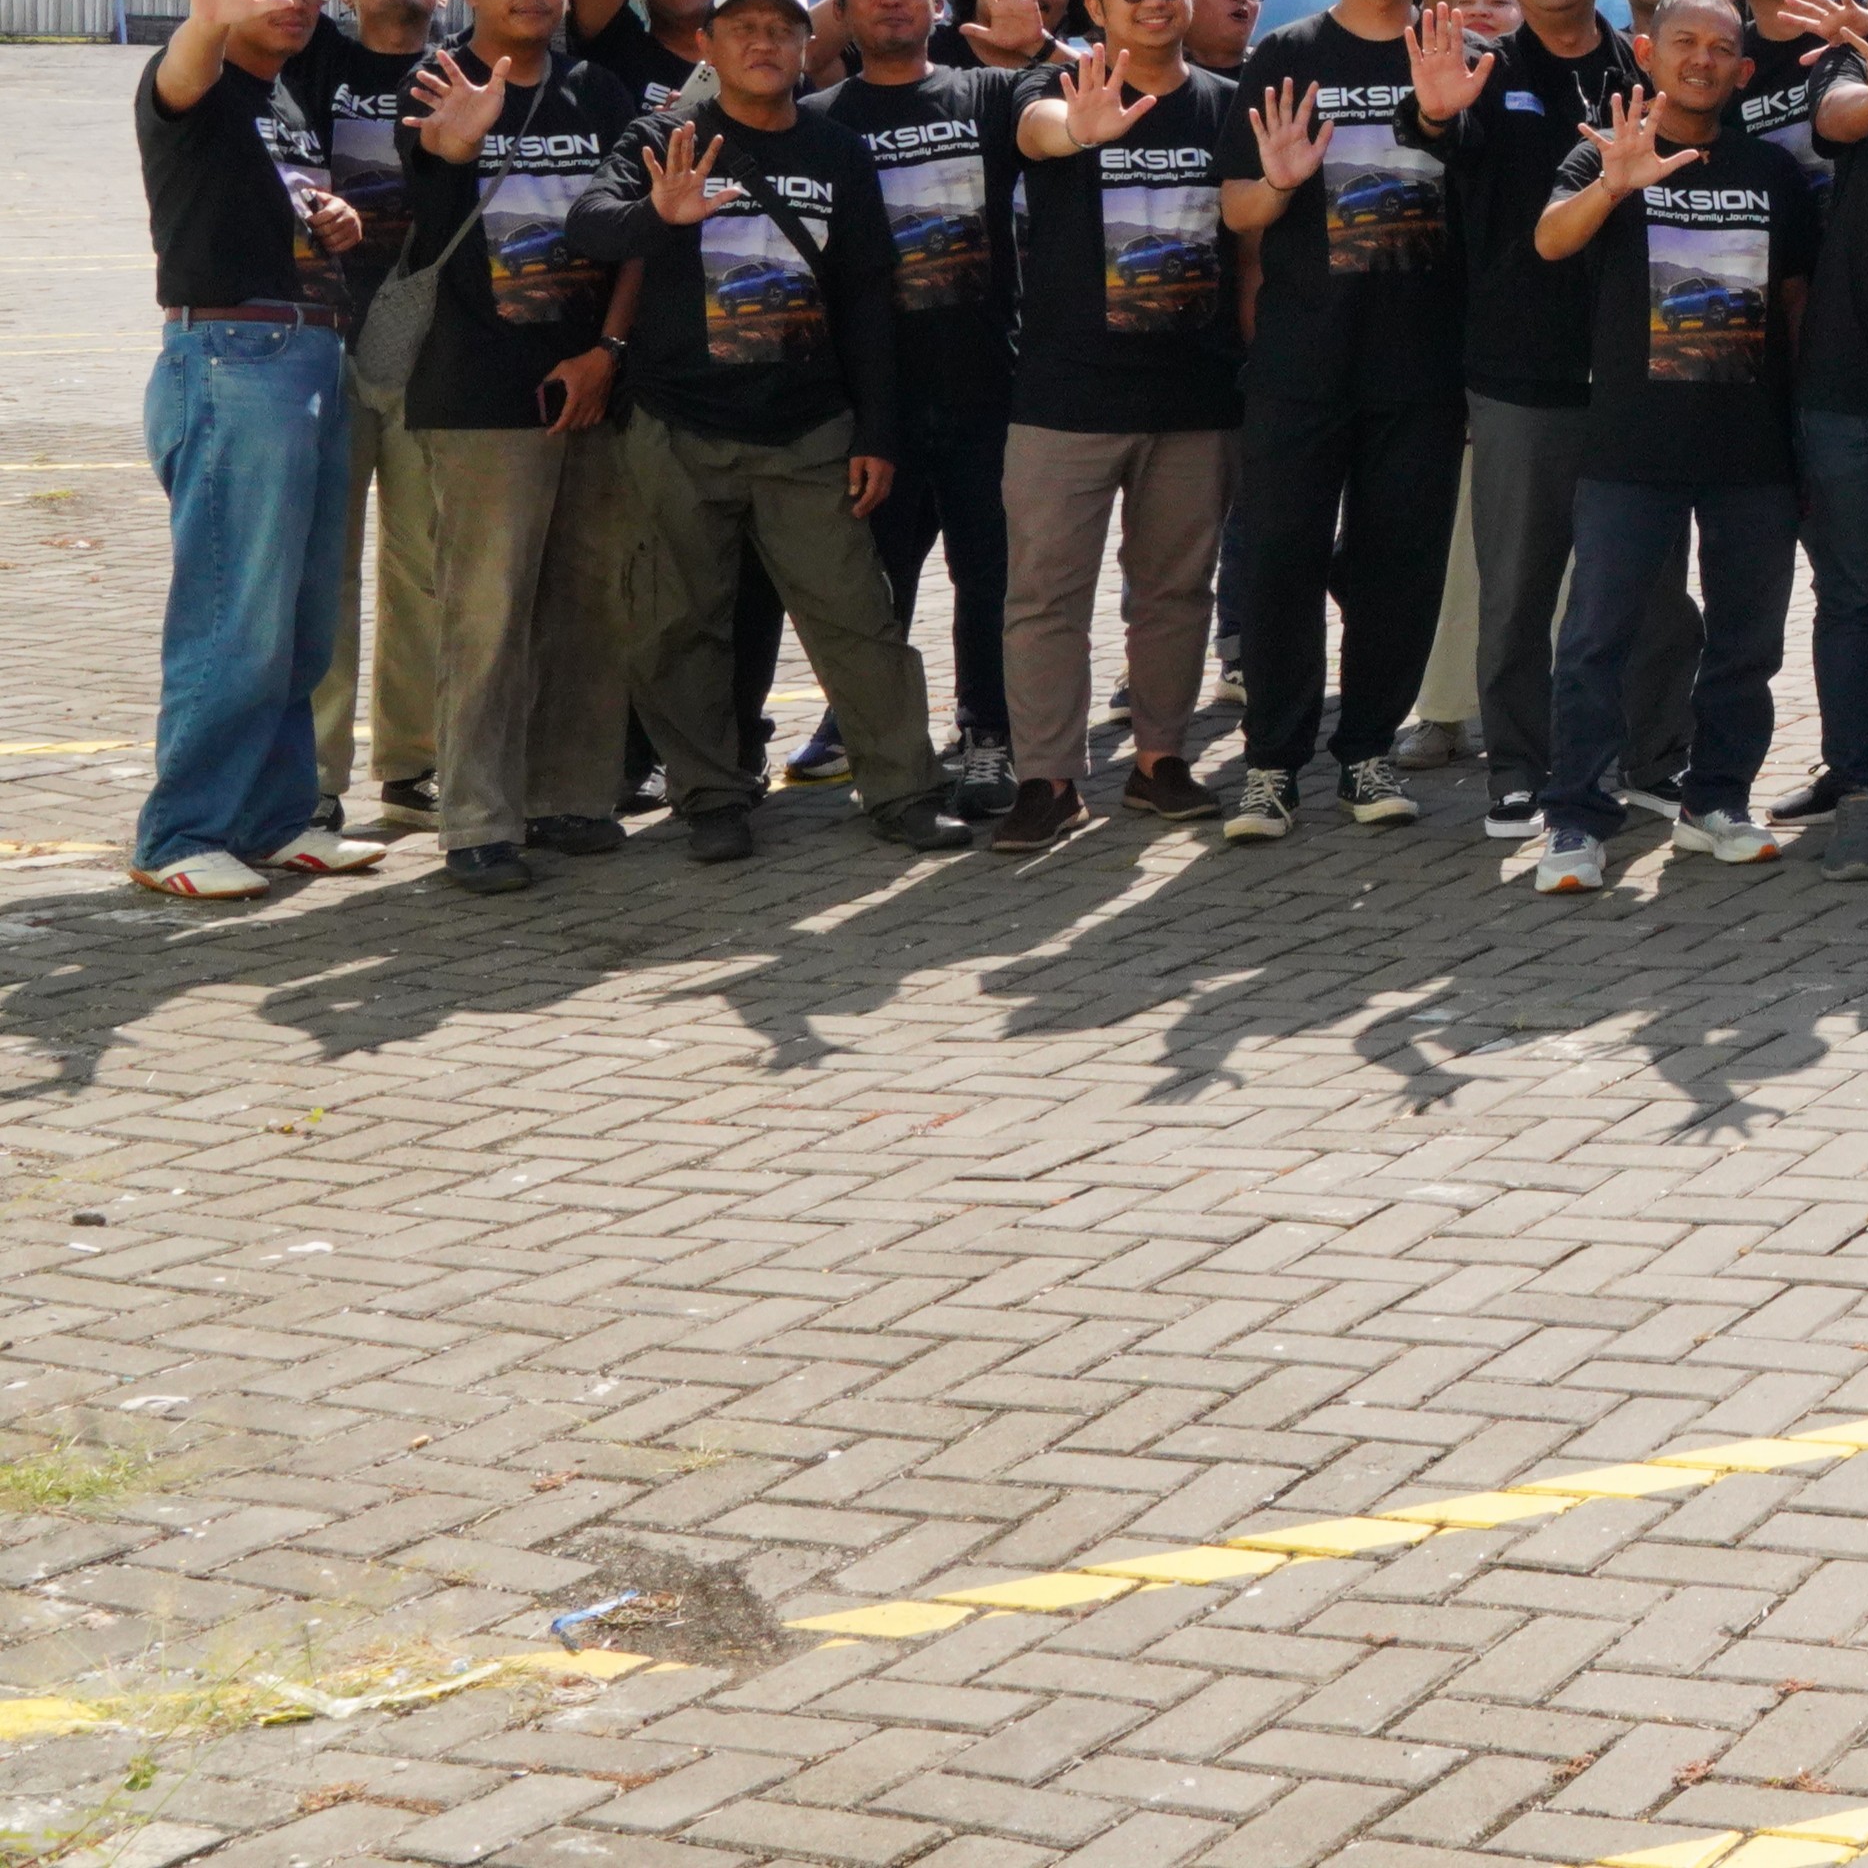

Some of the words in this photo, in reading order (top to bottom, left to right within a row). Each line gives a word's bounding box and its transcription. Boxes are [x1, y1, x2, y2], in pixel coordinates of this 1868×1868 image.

[335, 83, 398, 115] EKS
[1316, 85, 1415, 108] EKSI
[1318, 108, 1366, 121] Exploring
[1368, 108, 1395, 118] Famil
[481, 134, 600, 157] EKSION
[861, 119, 979, 151] KSION
[901, 147, 931, 160] Family
[933, 141, 980, 153] Journeys
[1147, 171, 1178, 181] Family
[1180, 170, 1207, 179] Jour
[788, 199, 833, 214] Journeys
[1643, 186, 1770, 211] EKSION
[1646, 207, 1690, 222] Exploring
[1691, 213, 1724, 223] Family
[1725, 213, 1770, 224] Journeys
